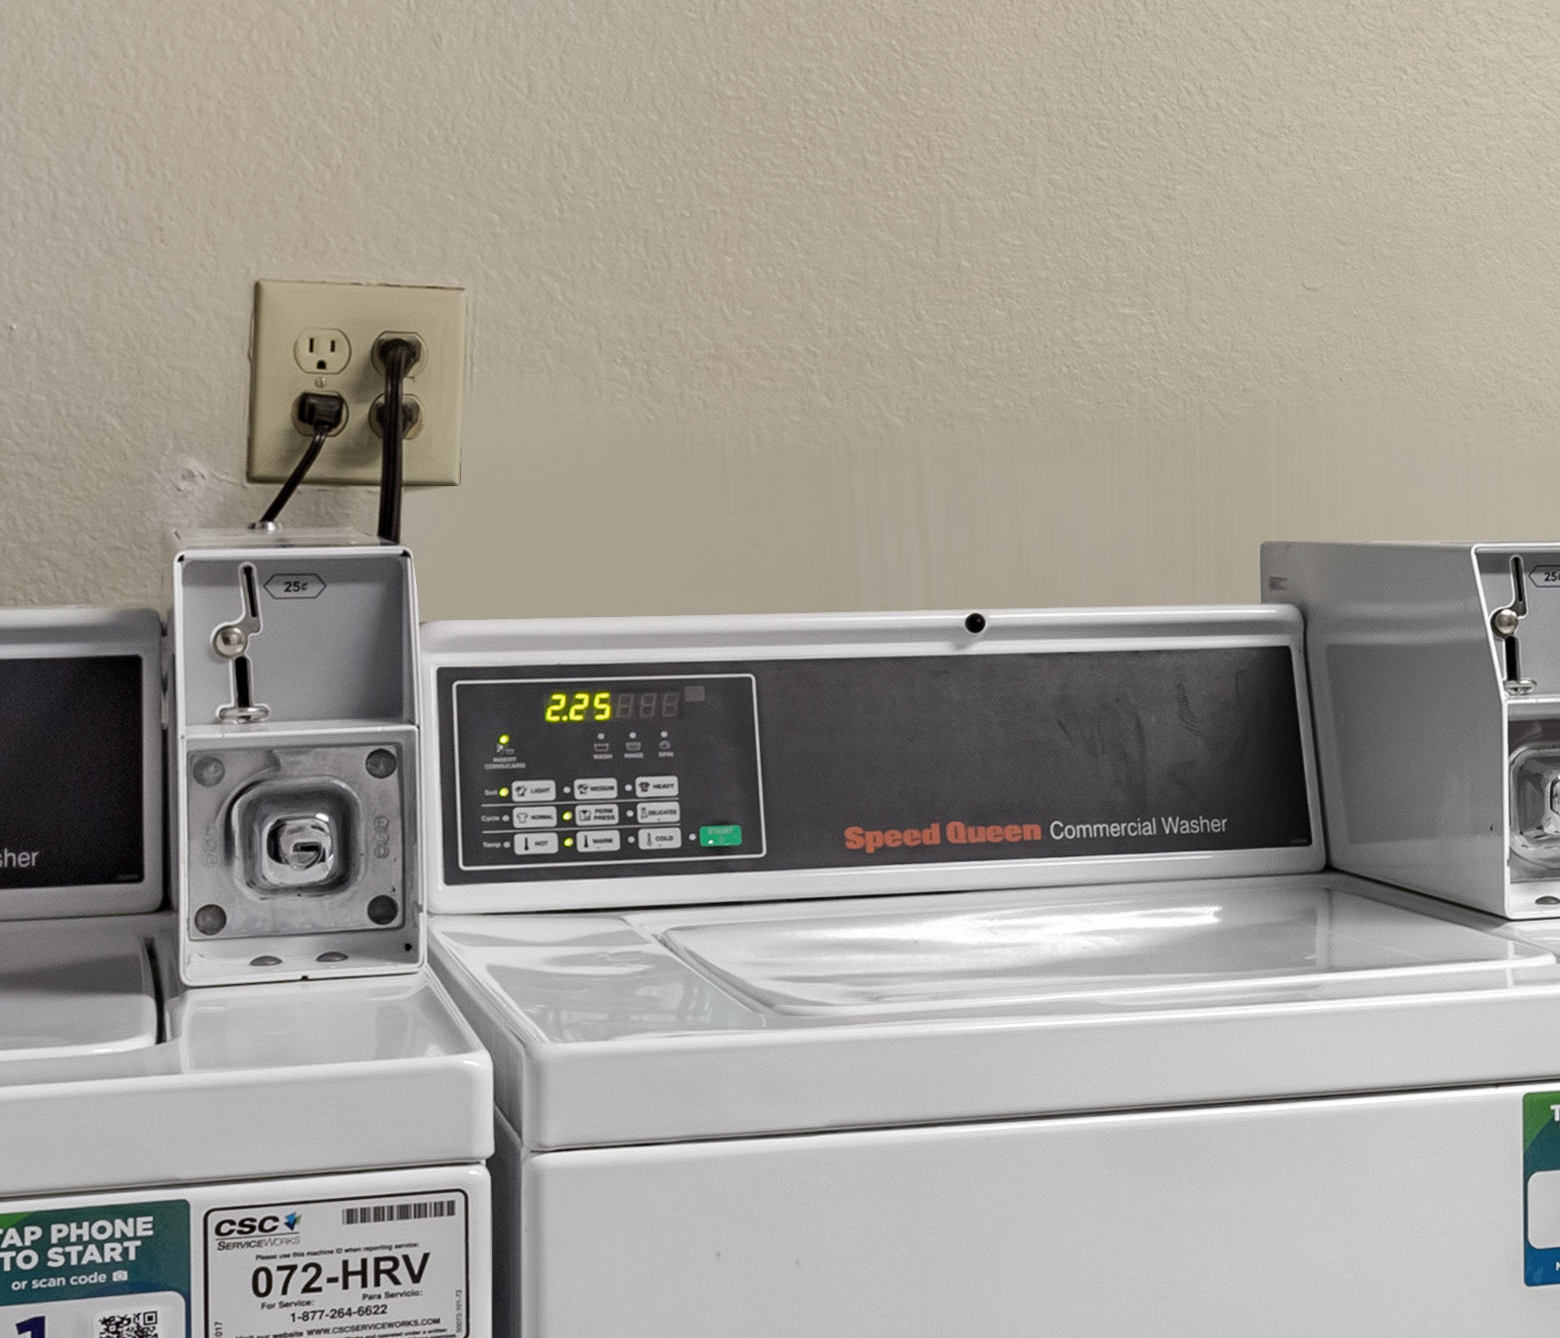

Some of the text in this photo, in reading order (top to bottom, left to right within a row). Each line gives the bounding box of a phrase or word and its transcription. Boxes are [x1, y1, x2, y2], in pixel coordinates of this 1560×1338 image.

[544, 690, 613, 723] 2.25
[843, 815, 1229, 855] Speed Queen Commercial Washer
[50, 1215, 155, 1243] PHONE
[213, 1213, 281, 1238] CSC
[46, 1238, 143, 1267] START
[10, 1270, 108, 1291] or scan code
[250, 1252, 432, 1299] 072-HRV
[289, 1303, 389, 1324] 1-877-264-6622
